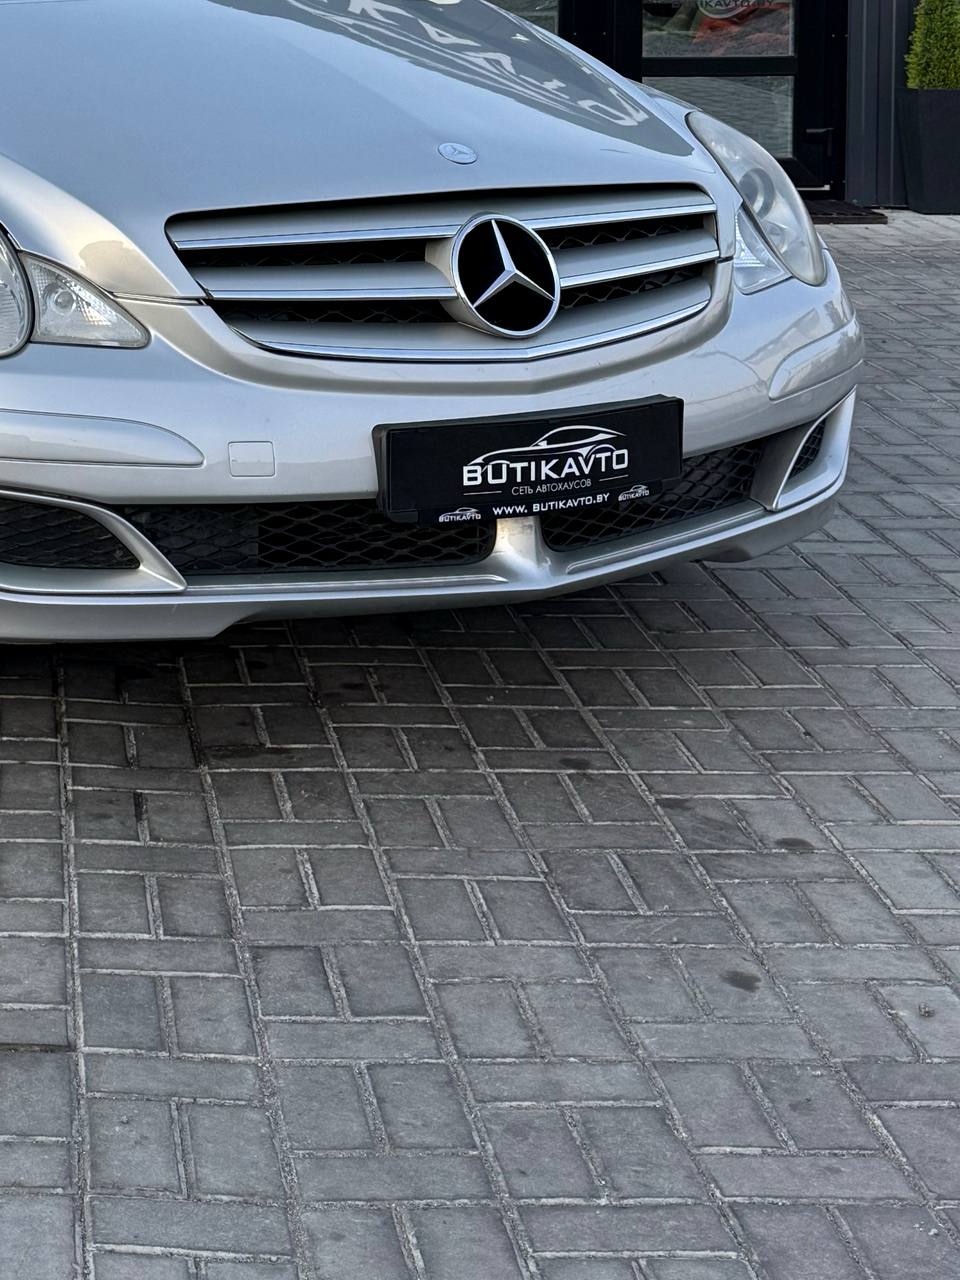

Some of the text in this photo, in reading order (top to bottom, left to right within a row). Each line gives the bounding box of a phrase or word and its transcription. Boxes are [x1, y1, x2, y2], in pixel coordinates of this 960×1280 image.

[462, 450, 628, 486] BUTIKAVTO
[512, 479, 592, 495] СЕТЬ АВТОХАУСОВ
[492, 493, 610, 516] WWW. BUTIKAVTO.BY
[439, 513, 481, 522] BUTIKAVTO
